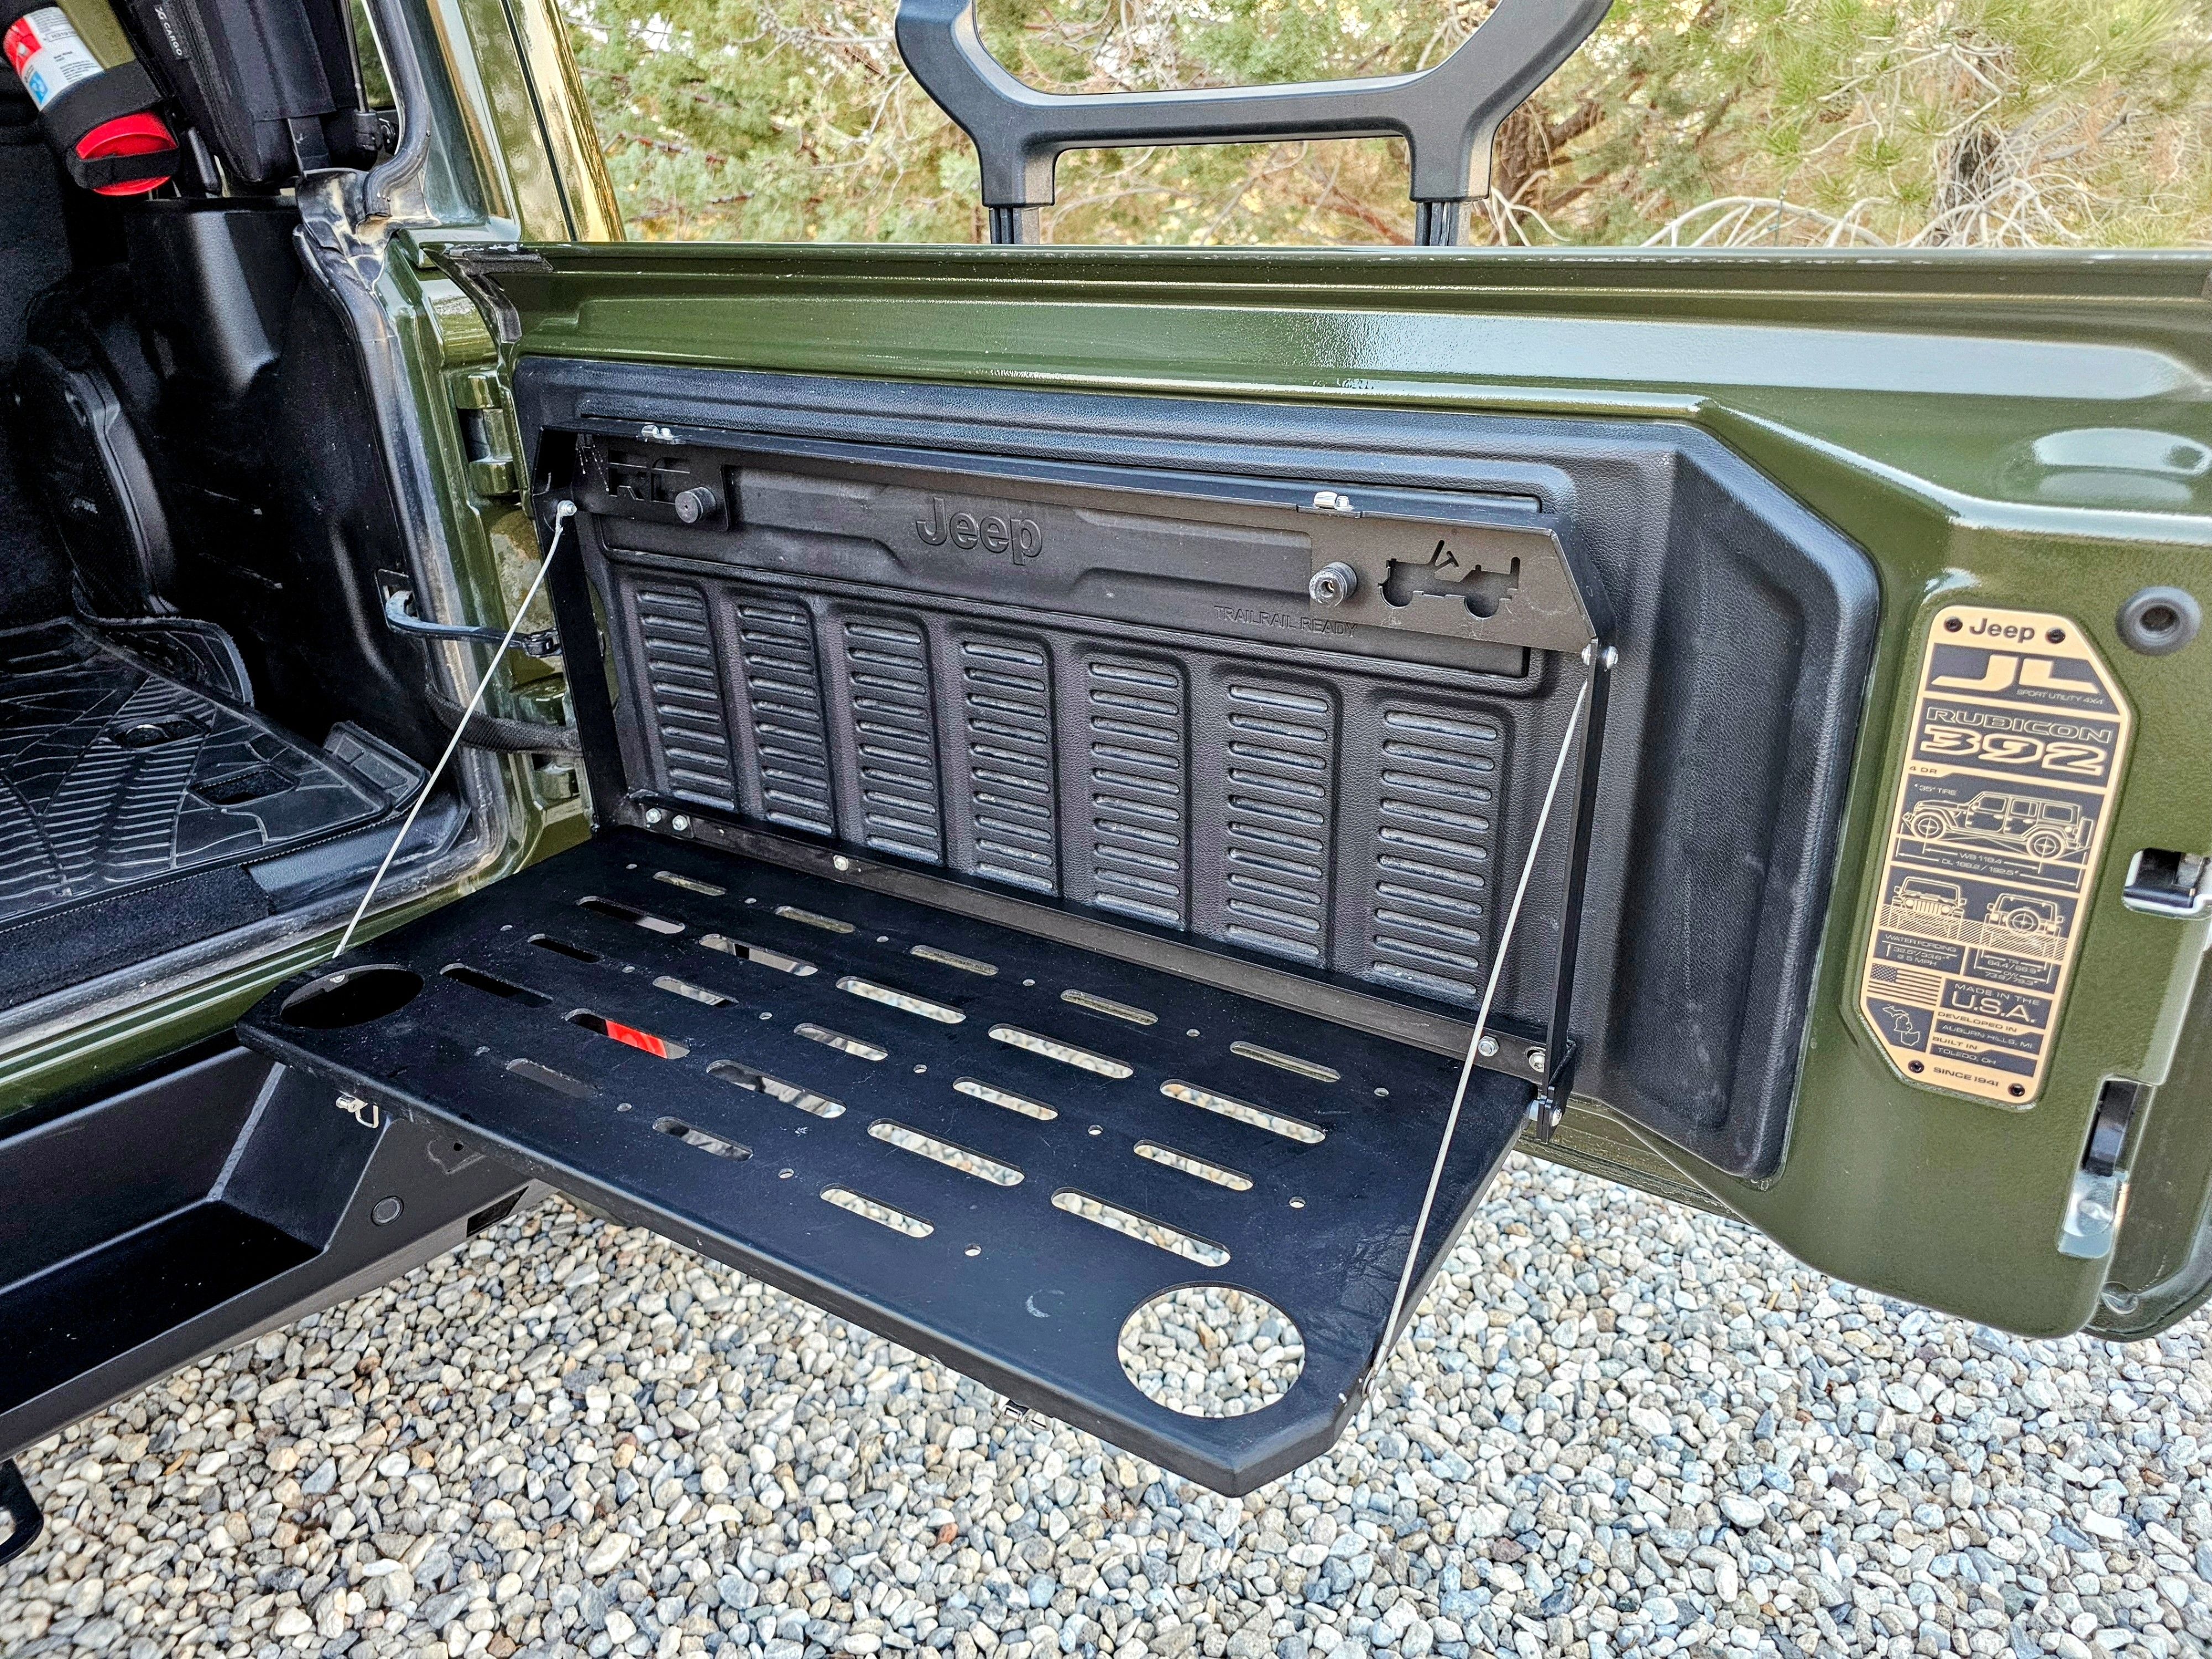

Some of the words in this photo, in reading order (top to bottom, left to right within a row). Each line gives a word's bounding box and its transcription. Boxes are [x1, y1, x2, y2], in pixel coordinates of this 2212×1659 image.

[164, 22, 182, 55] CARGO
[916, 497, 1042, 566] Jeep
[1300, 617, 1358, 638] READY
[1969, 618, 2035, 644] Jeep
[1932, 654, 2100, 693] JL
[2016, 689, 2047, 698] SPORT
[2048, 692, 2083, 702] UTILITY
[1927, 707, 2112, 744] RUBICON
[1920, 723, 2107, 776] 392
[1937, 787, 1958, 796] TIRE
[1959, 852, 1976, 860] WB
[1885, 933, 1916, 945] WATER
[1917, 940, 1957, 953] FORDING
[1914, 957, 1937, 966] MPH
[1955, 983, 1992, 997] MADE
[2014, 995, 2041, 1006] THE
[1952, 990, 2037, 1024] U.S.A.
[1938, 1011, 2004, 1030] DEVELOPED
[1932, 1036, 1963, 1047] BUILT
[1942, 1025, 1985, 1039] AUBURN
[2020, 1041, 2033, 1050] MI
[1981, 1057, 1997, 1065] OH
[1933, 1067, 1973, 1081] SINCE
[1974, 1076, 1999, 1087] 1941
